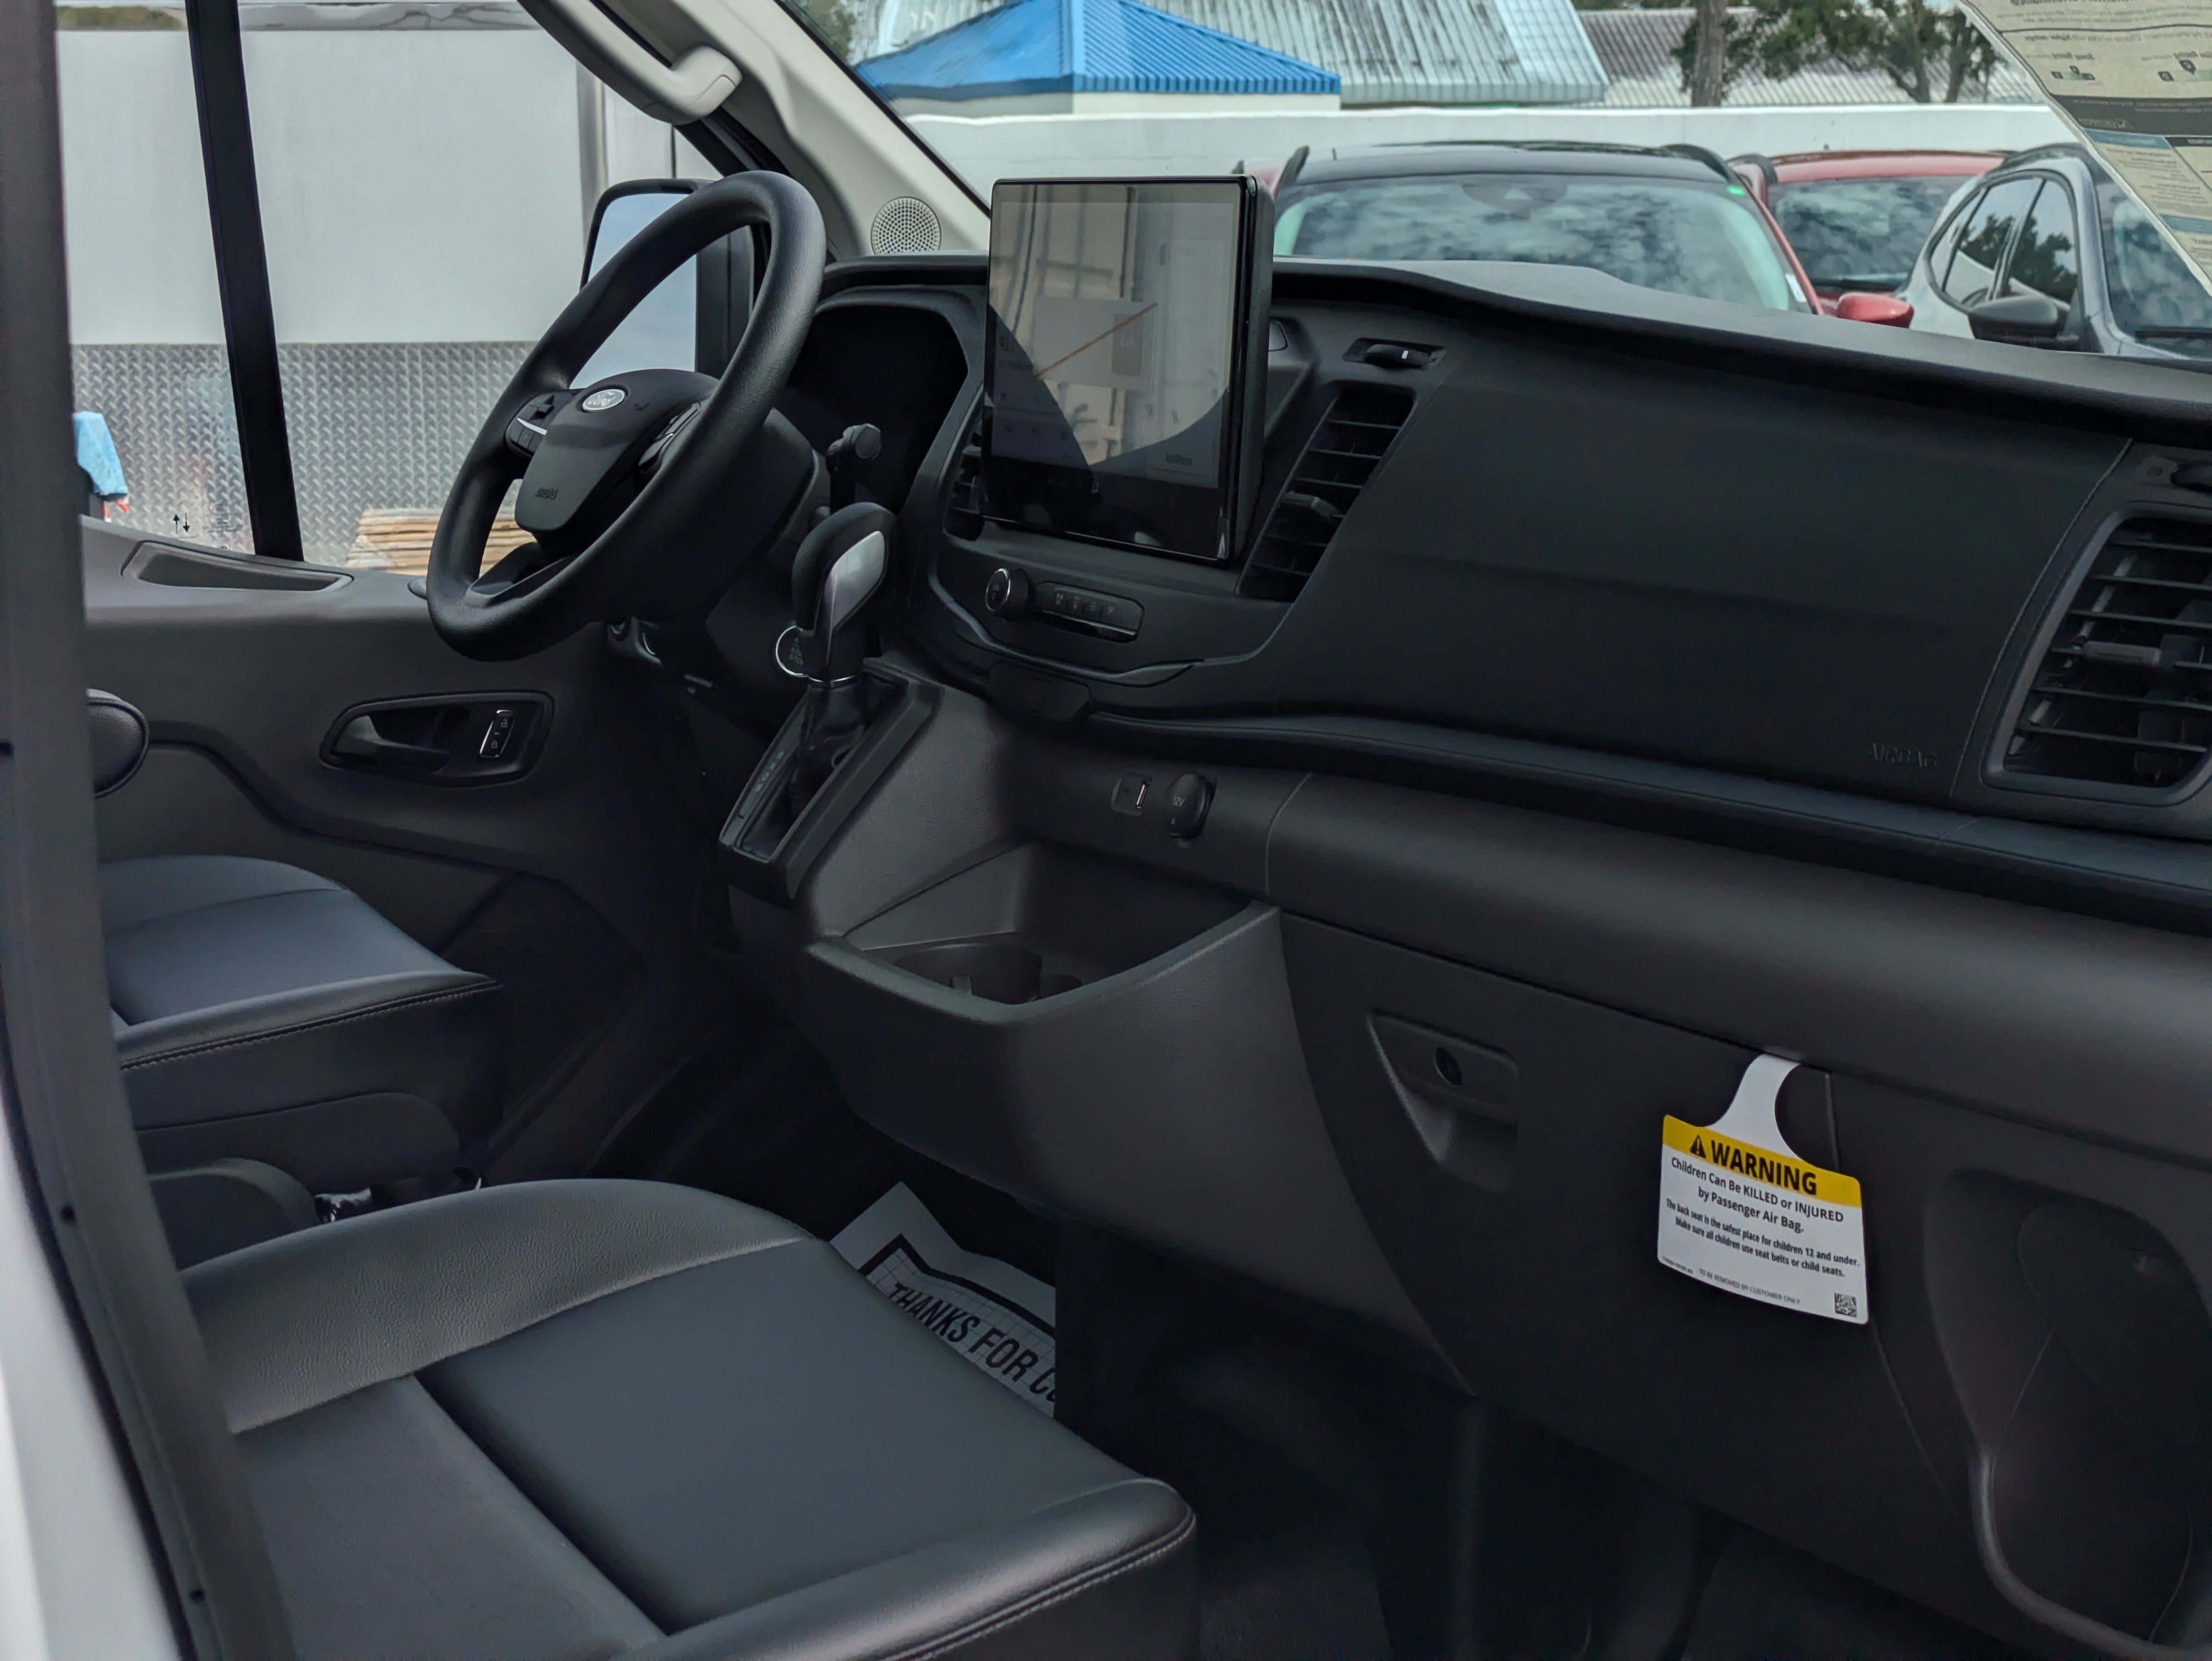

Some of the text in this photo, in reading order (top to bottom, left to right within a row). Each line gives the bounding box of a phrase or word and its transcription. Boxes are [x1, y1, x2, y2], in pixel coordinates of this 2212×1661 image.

[1671, 1157, 1844, 1222] Children Can Be KILLED or INJURED
[1711, 1139, 1817, 1196] WARNING
[1667, 1198, 1859, 1267] The back seat is the safest place for children 12 and under.
[1698, 1186, 1804, 1233] by Passenger Air Bag.
[1676, 1217, 1691, 1231] Make
[1692, 1226, 1705, 1237] sure
[1706, 1230, 1714, 1240] all
[1715, 1234, 1740, 1250] children
[1742, 1244, 1753, 1254] use
[1755, 1249, 1770, 1260] seat
[1771, 1251, 1789, 1265] belts
[1791, 1259, 1799, 1267] or
[1802, 1260, 1820, 1272] child
[888, 1283, 981, 1342] THANKS
[968, 1328, 1038, 1383] FOR
